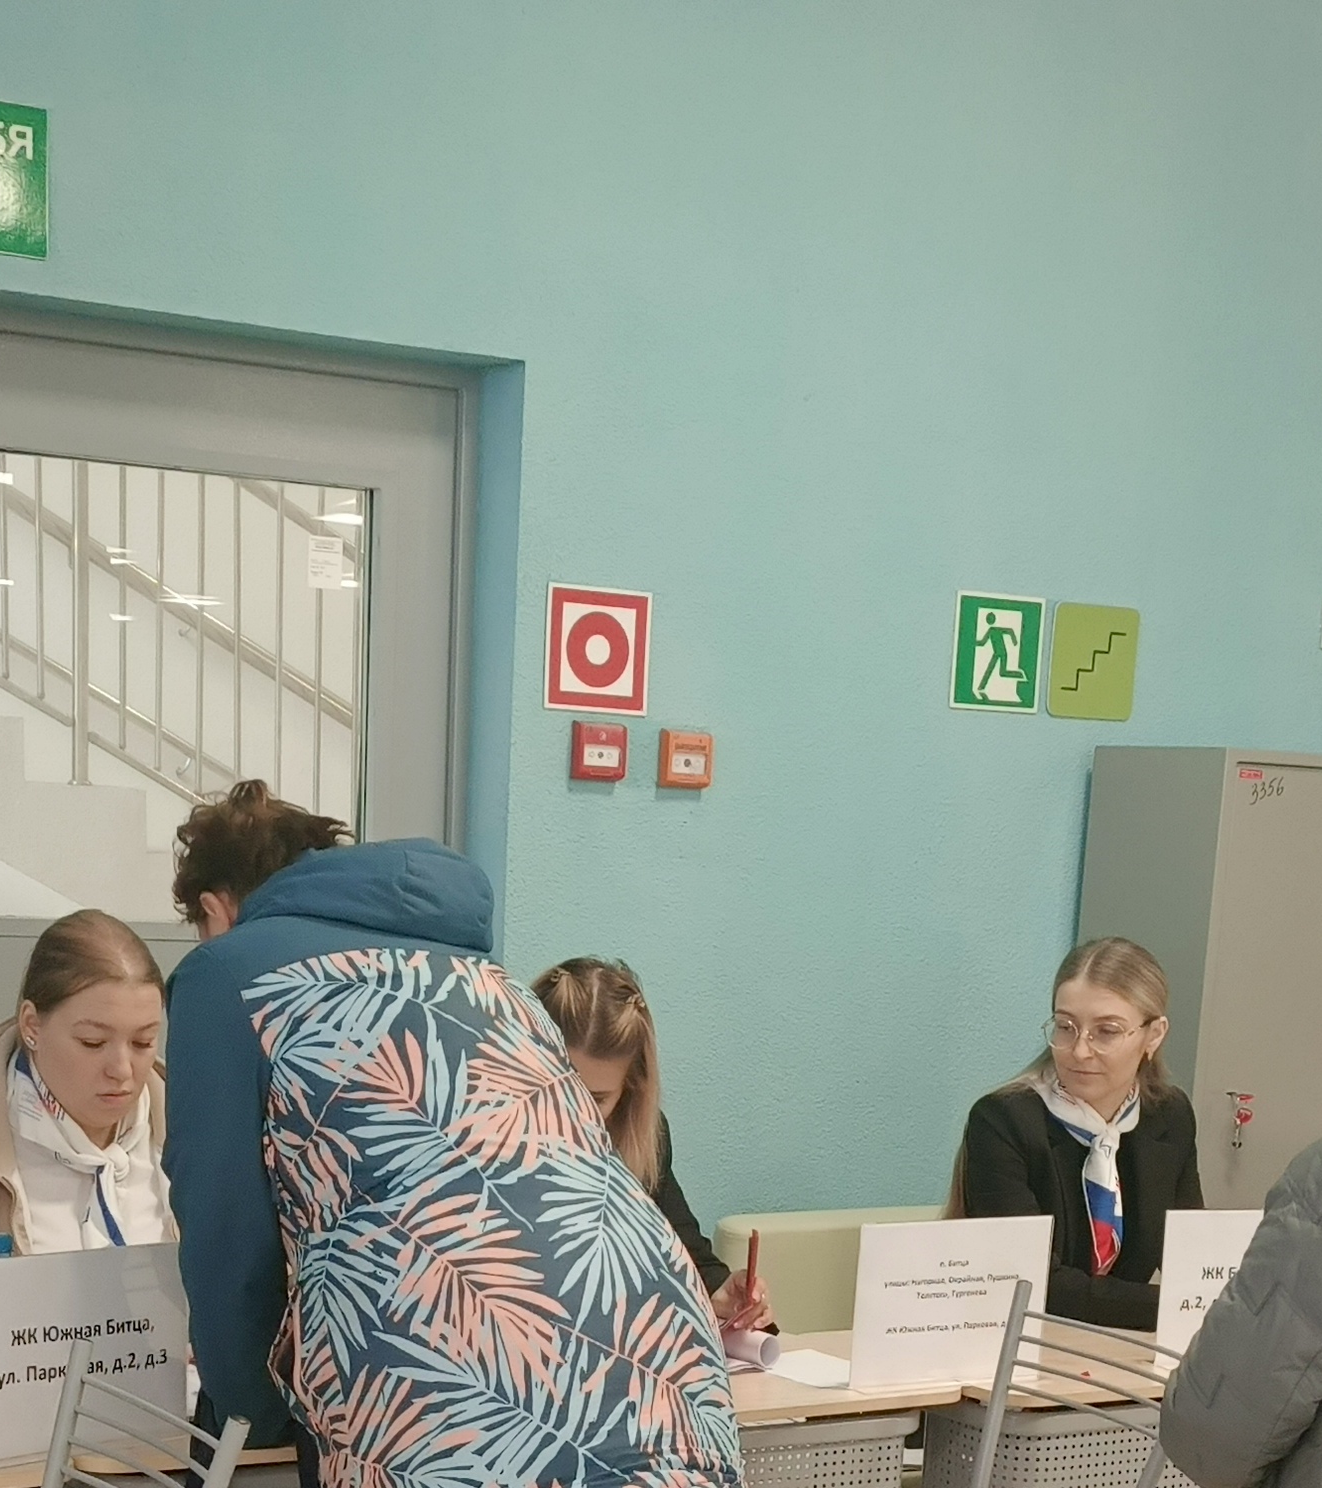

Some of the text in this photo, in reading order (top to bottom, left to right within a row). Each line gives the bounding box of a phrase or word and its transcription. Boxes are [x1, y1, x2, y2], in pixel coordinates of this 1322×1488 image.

[1201, 1266, 1224, 1280] ЖК
[11, 1318, 155, 1346] ЖК Южная Битца,
[27, 1360, 108, 1382] Паркая,
[112, 1352, 140, 1374] д.2,
[144, 1348, 168, 1370] д.3
